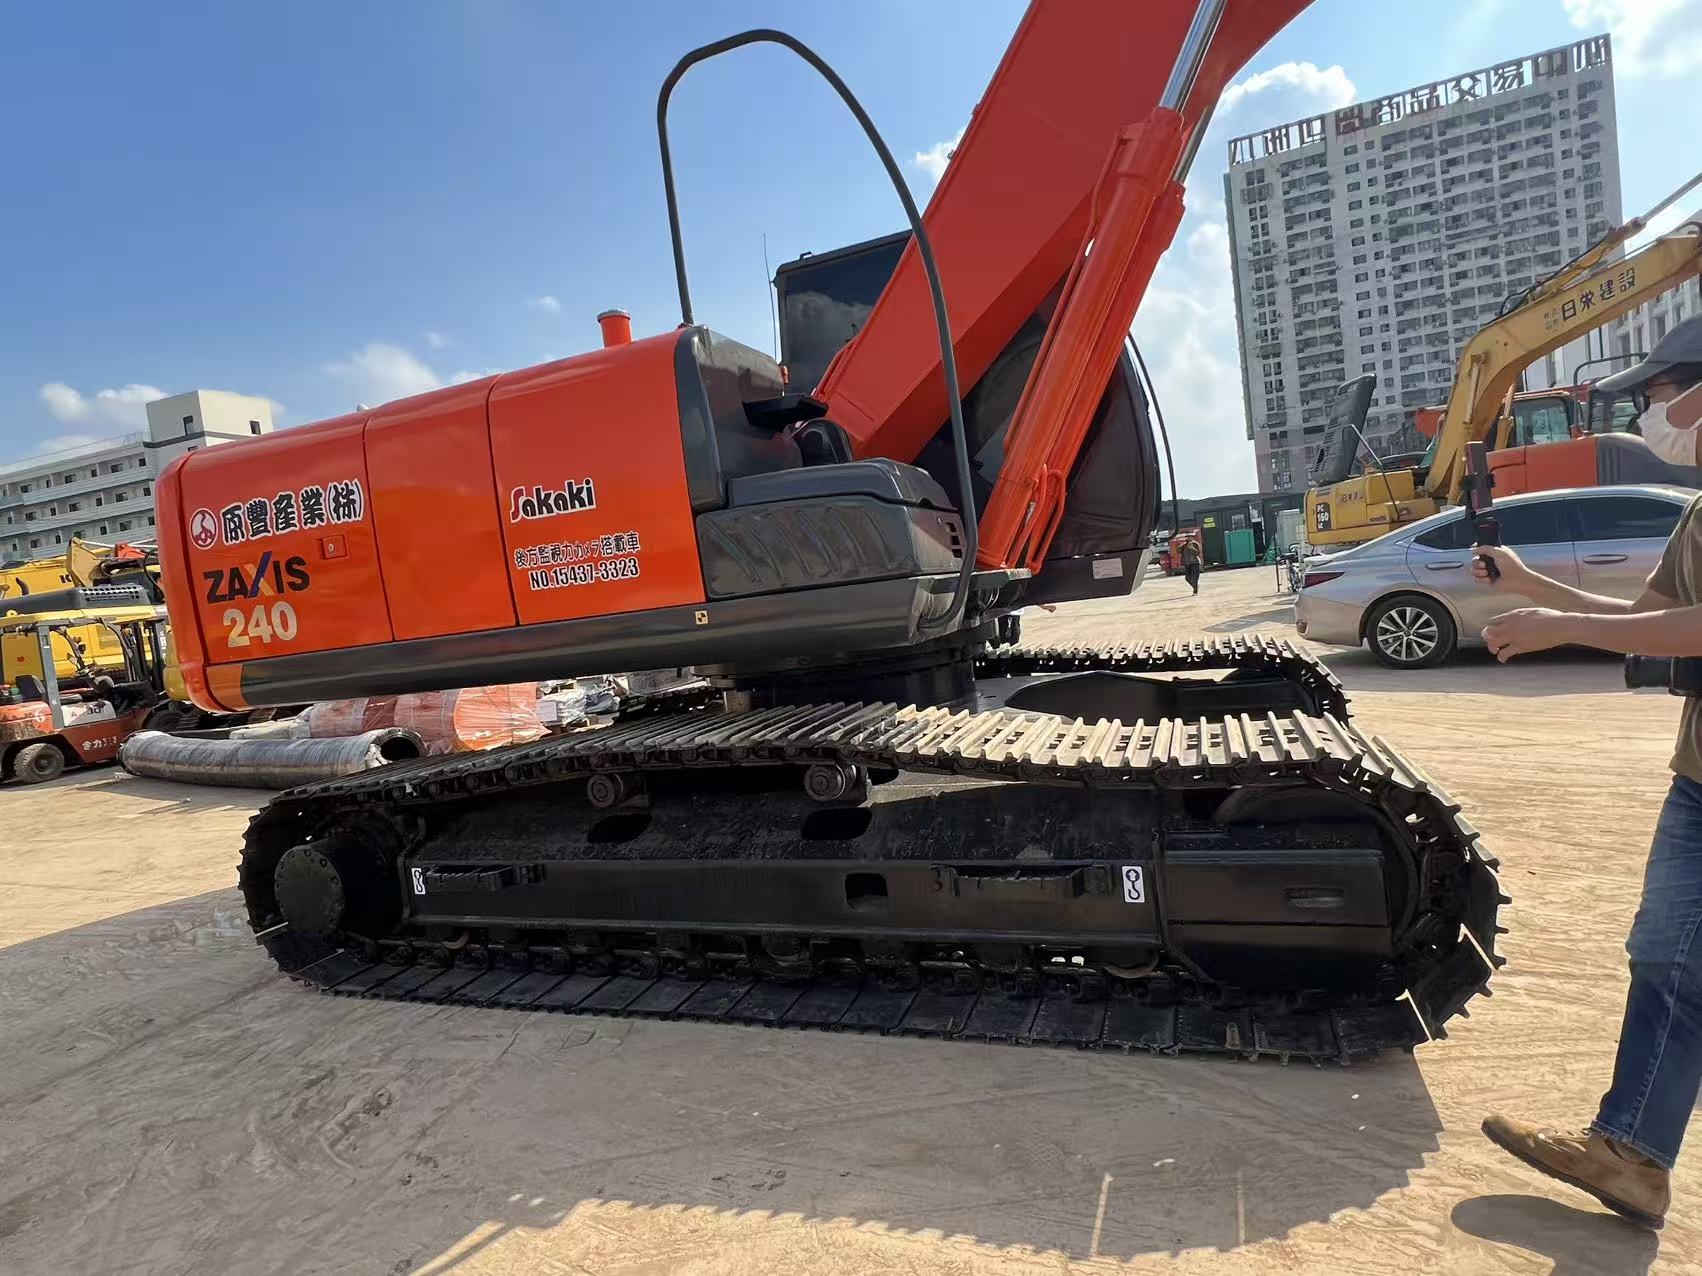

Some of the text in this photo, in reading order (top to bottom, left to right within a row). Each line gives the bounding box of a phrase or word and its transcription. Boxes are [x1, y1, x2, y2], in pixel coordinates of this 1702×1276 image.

[510, 478, 597, 523] Sakaki
[204, 551, 311, 604] ZAXIS
[529, 557, 640, 591] NO.15437-3323
[223, 601, 298, 648] 240
